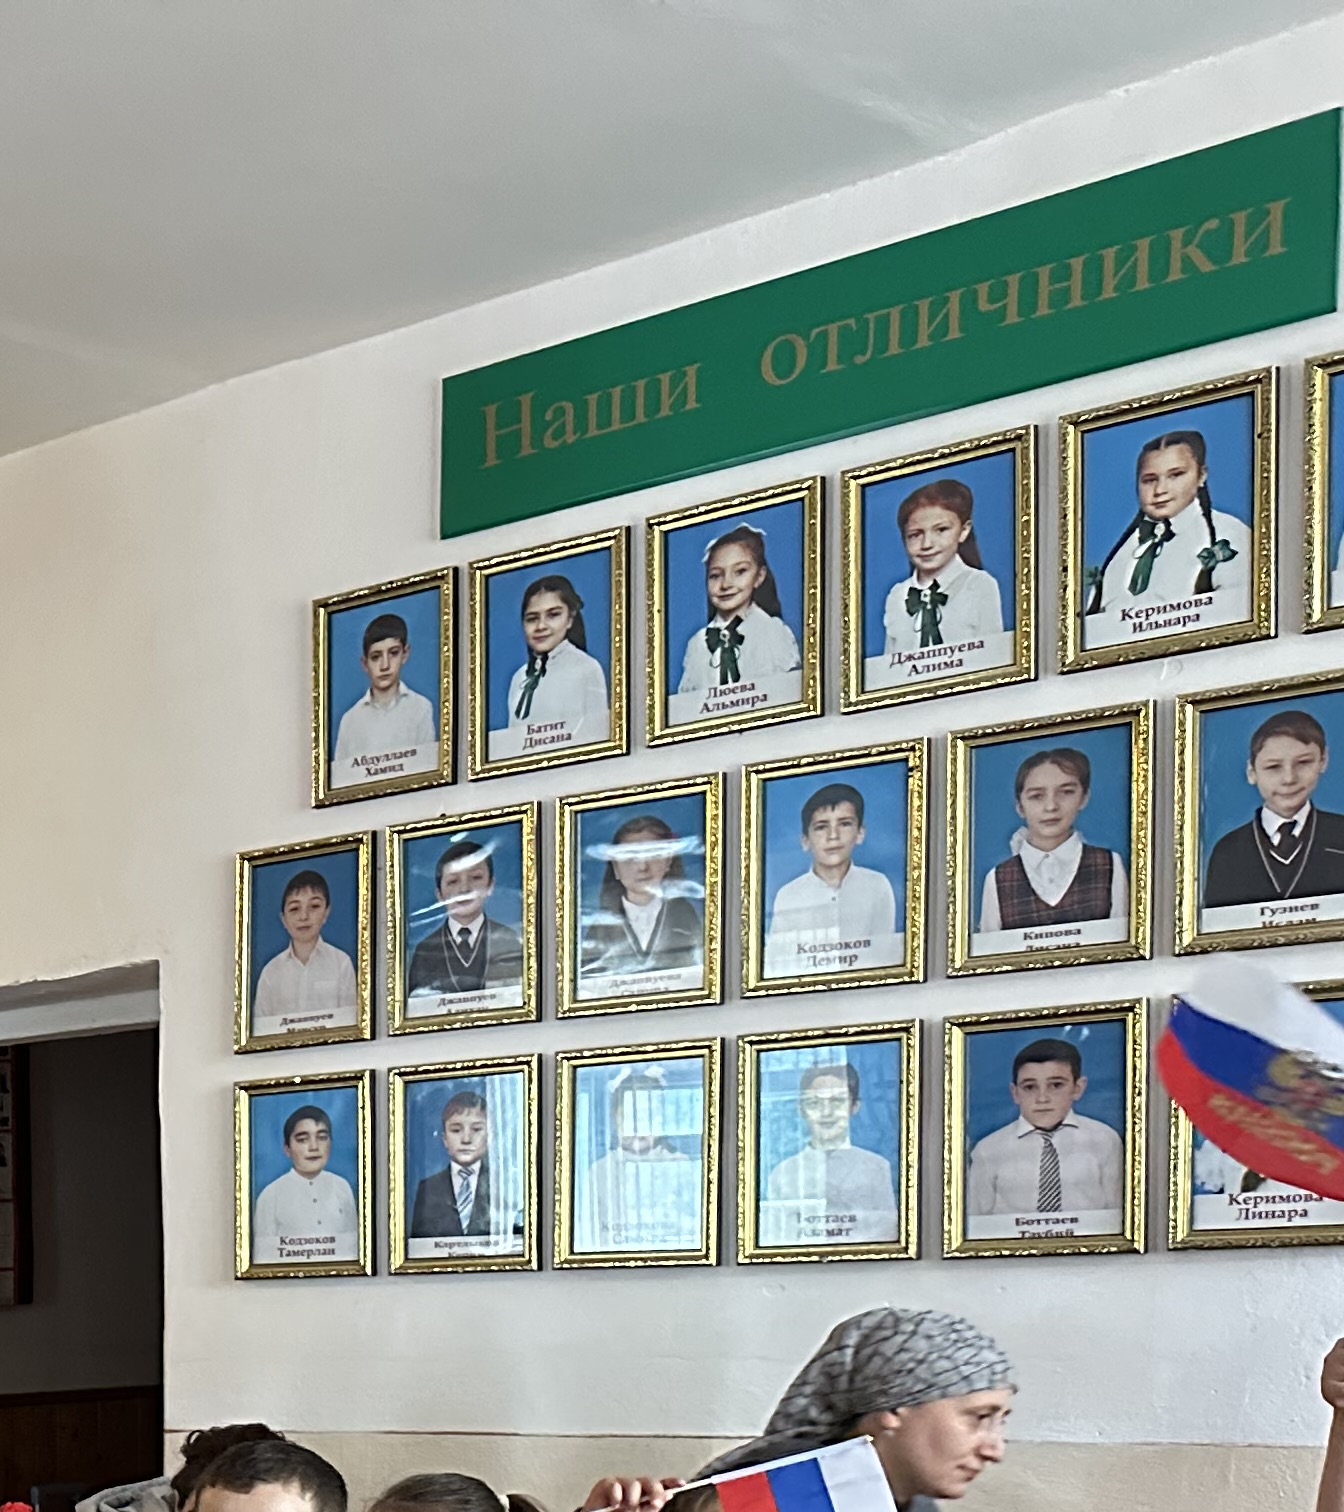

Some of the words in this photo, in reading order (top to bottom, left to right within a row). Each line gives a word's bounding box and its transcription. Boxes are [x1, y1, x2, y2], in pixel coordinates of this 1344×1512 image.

[479, 361, 703, 470] Наши
[760, 198, 1293, 387] отличники
[1120, 596, 1213, 622] Керимова
[1132, 613, 1200, 634] Ильнара
[889, 639, 985, 669] Джаппуева
[907, 658, 963, 677] Алима
[705, 682, 756, 700] Люева
[699, 693, 768, 714] Альмира
[351, 748, 417, 768] Абдуллаев
[1228, 1193, 1323, 1208] Керимова
[1235, 1207, 1309, 1222] Линара
[277, 1247, 336, 1260] Тамерлан
